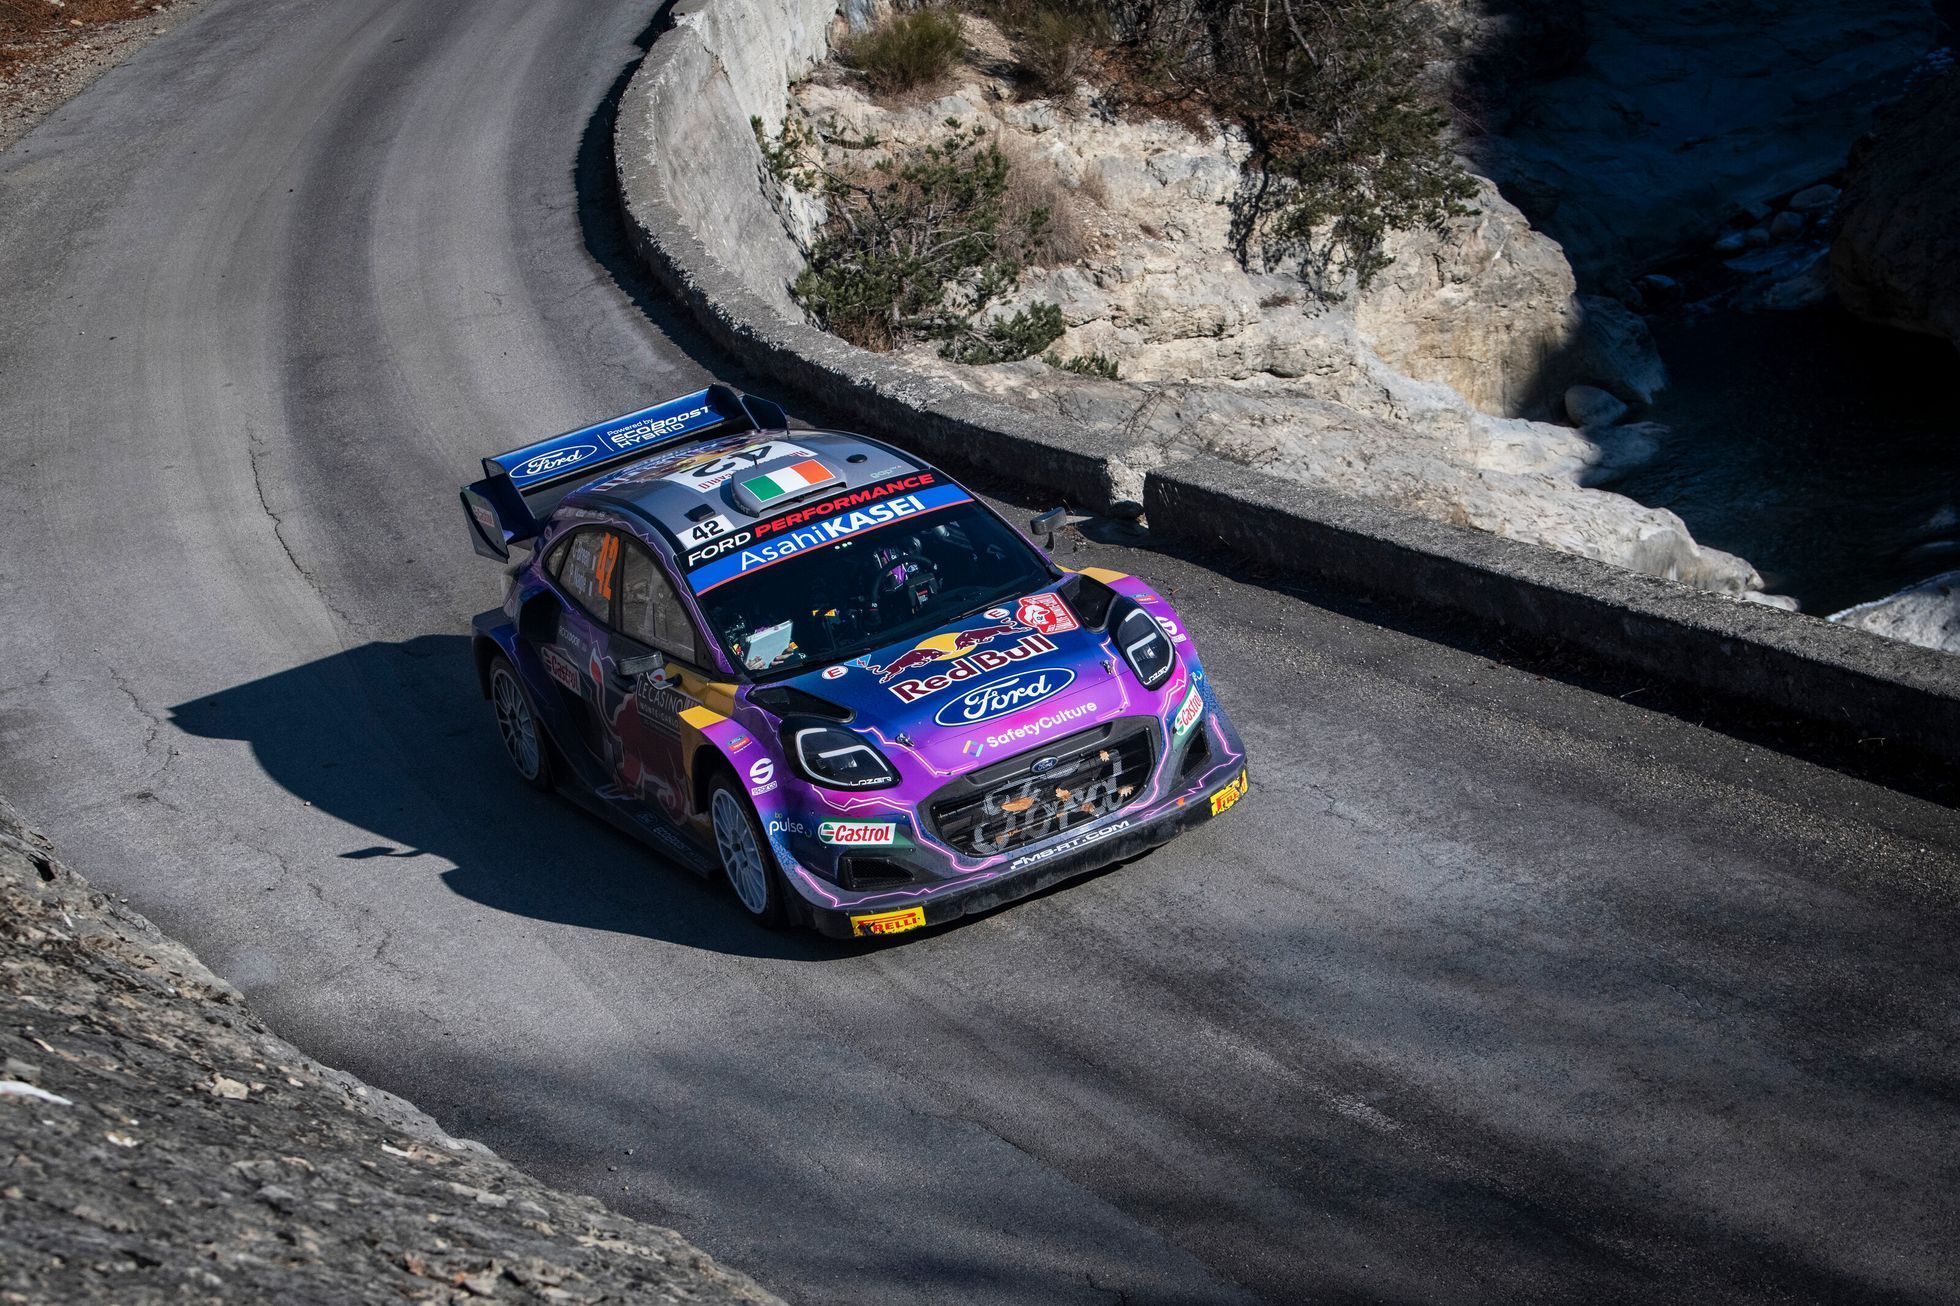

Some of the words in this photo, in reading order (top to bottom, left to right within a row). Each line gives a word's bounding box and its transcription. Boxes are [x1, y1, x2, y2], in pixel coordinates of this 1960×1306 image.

[607, 421, 643, 437] Powered
[642, 418, 654, 427] by
[611, 406, 710, 444] ECOBOOST
[617, 423, 685, 448] HYBRID
[526, 449, 583, 476] Ford
[688, 532, 751, 567] FORD
[755, 473, 935, 538] PERFORMANCE
[692, 520, 724, 541] 42
[827, 667, 843, 679] E
[891, 658, 980, 703] Red
[974, 633, 1057, 672] Bull
[963, 674, 1052, 720] Ford
[986, 700, 1098, 748] SafetyCulture
[769, 817, 804, 836] pulse
[835, 824, 890, 843] Castrol
[857, 912, 918, 934] RELLI
